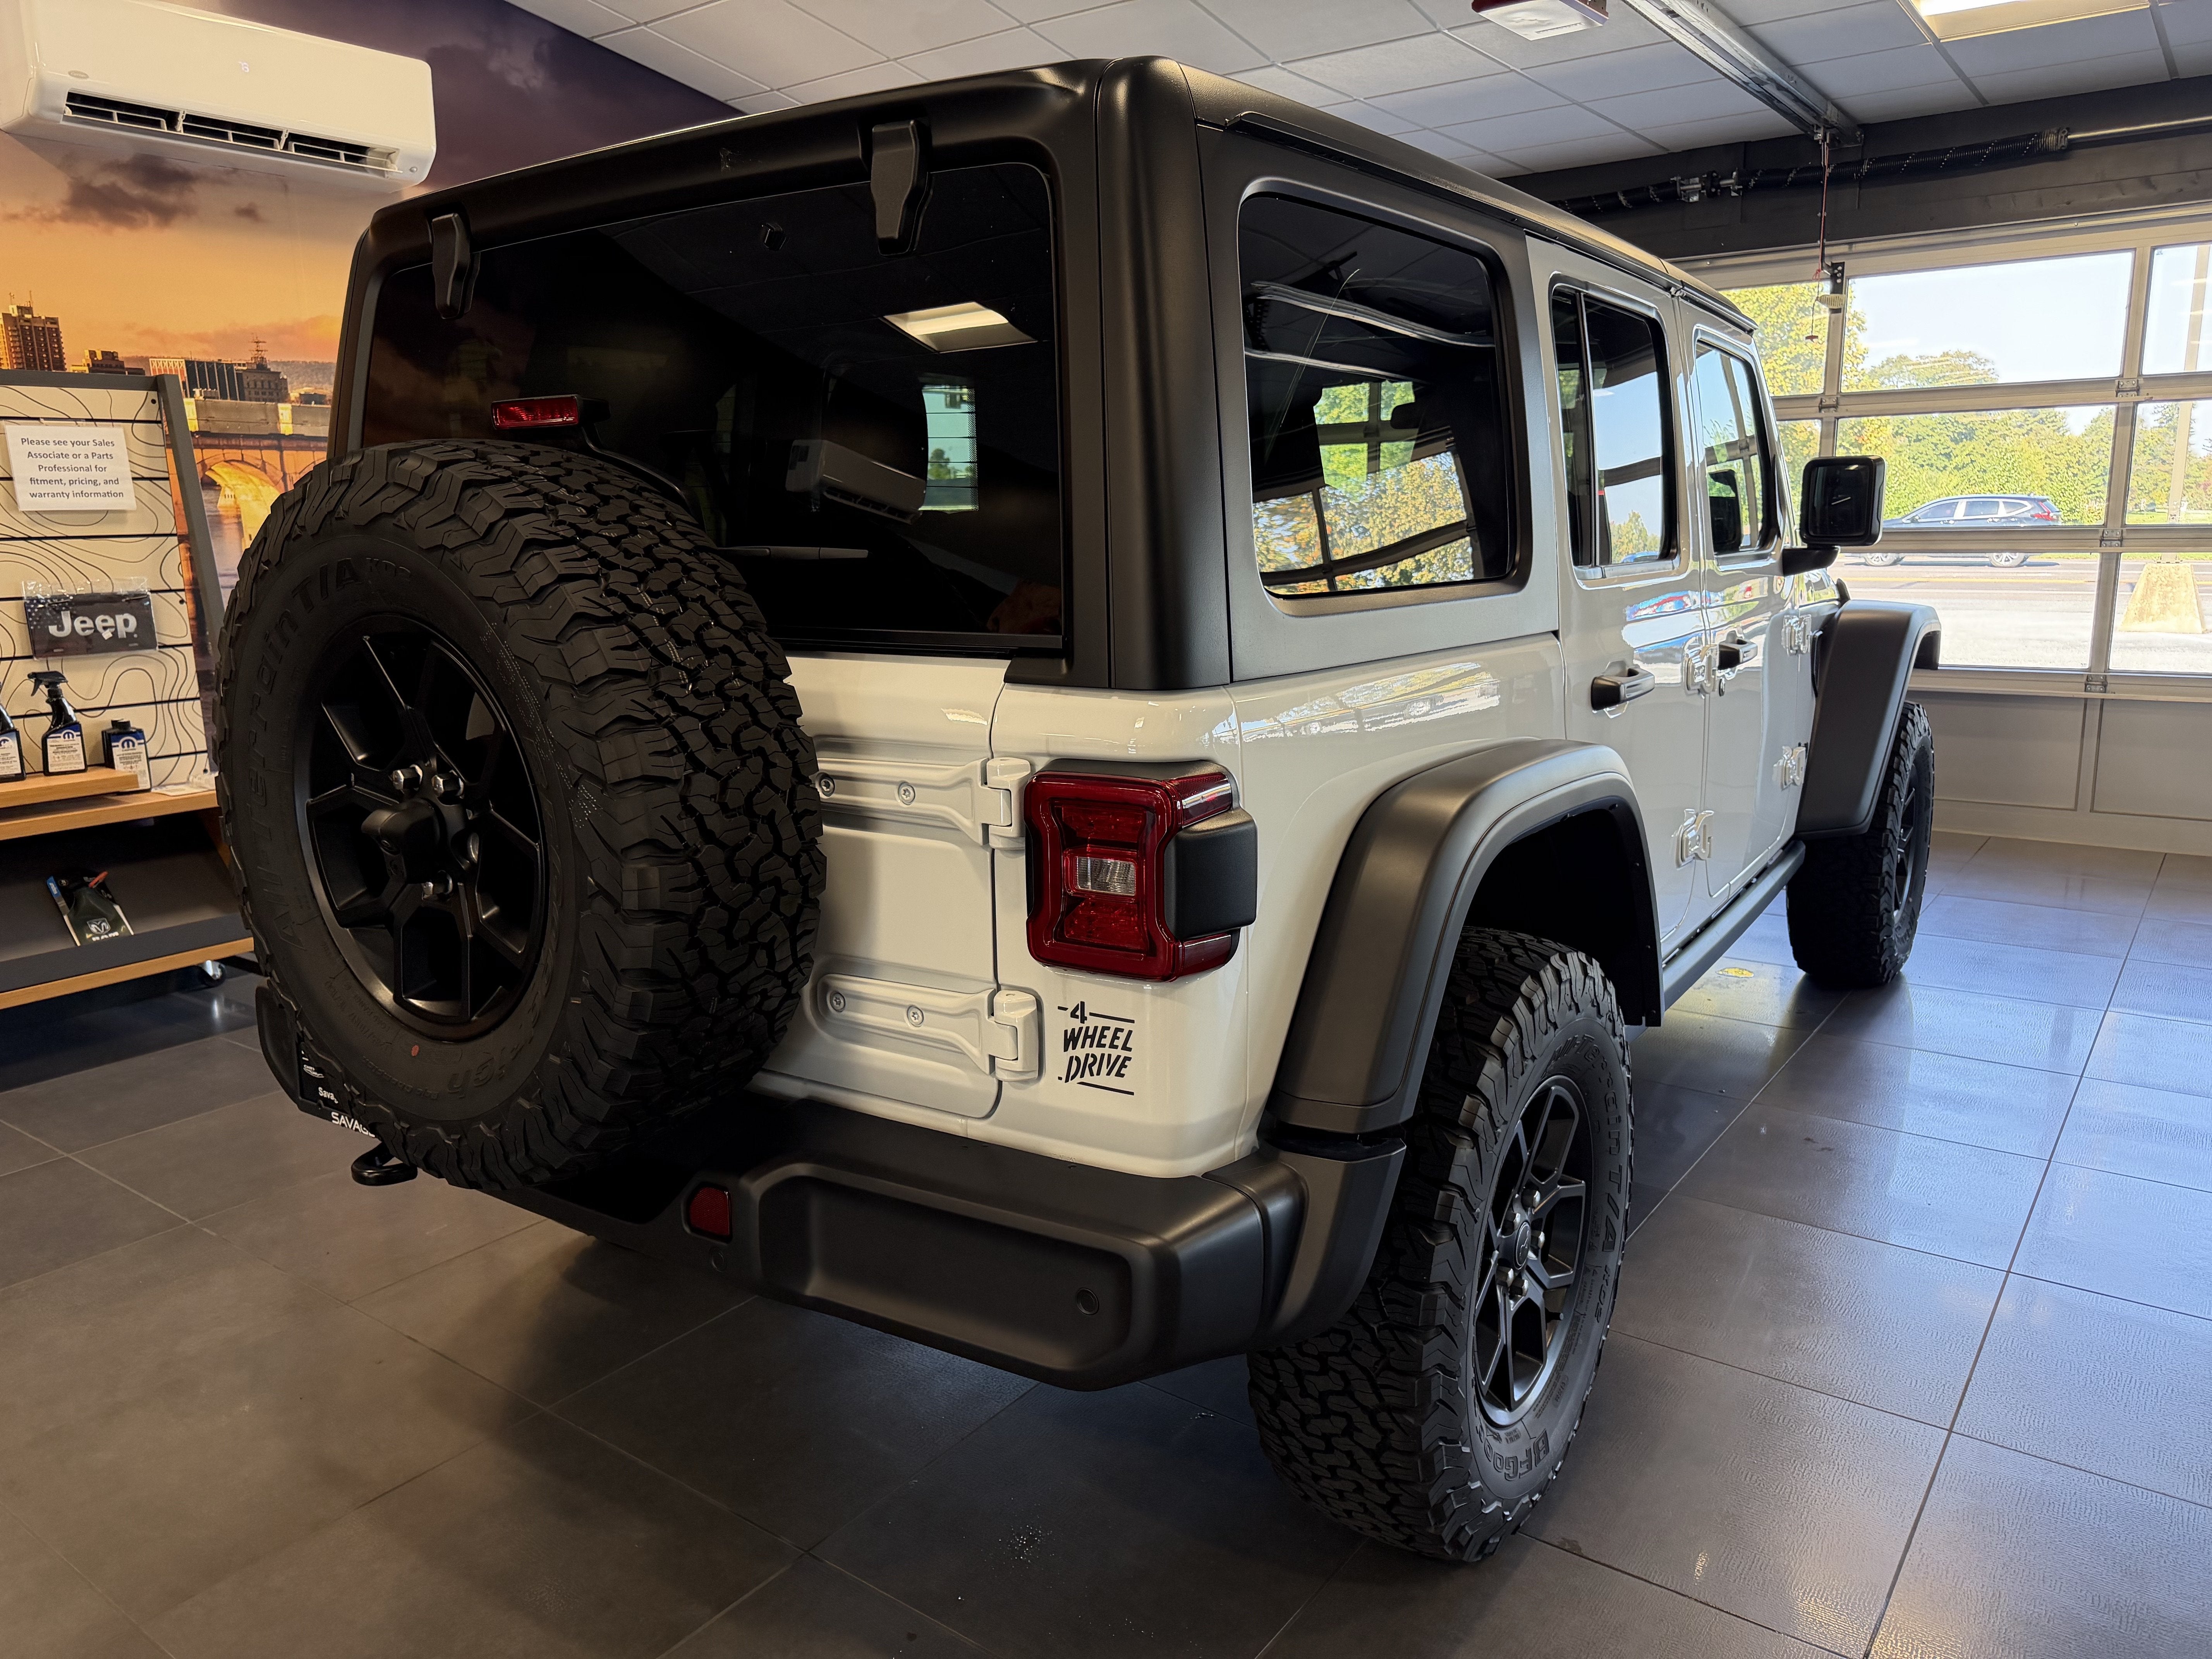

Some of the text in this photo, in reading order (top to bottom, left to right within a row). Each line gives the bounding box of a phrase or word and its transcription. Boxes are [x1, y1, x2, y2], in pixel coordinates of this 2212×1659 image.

[30, 477, 66, 486] fitment,
[69, 477, 101, 486] pricing,
[48, 610, 137, 639] Jeep
[1070, 1001, 1087, 1024] 4
[1063, 1025, 1133, 1052] WHEEL
[1065, 1053, 1132, 1083] DRIVE
[1602, 1164, 1622, 1252] T/A
[1595, 1265, 1609, 1323] KO2
